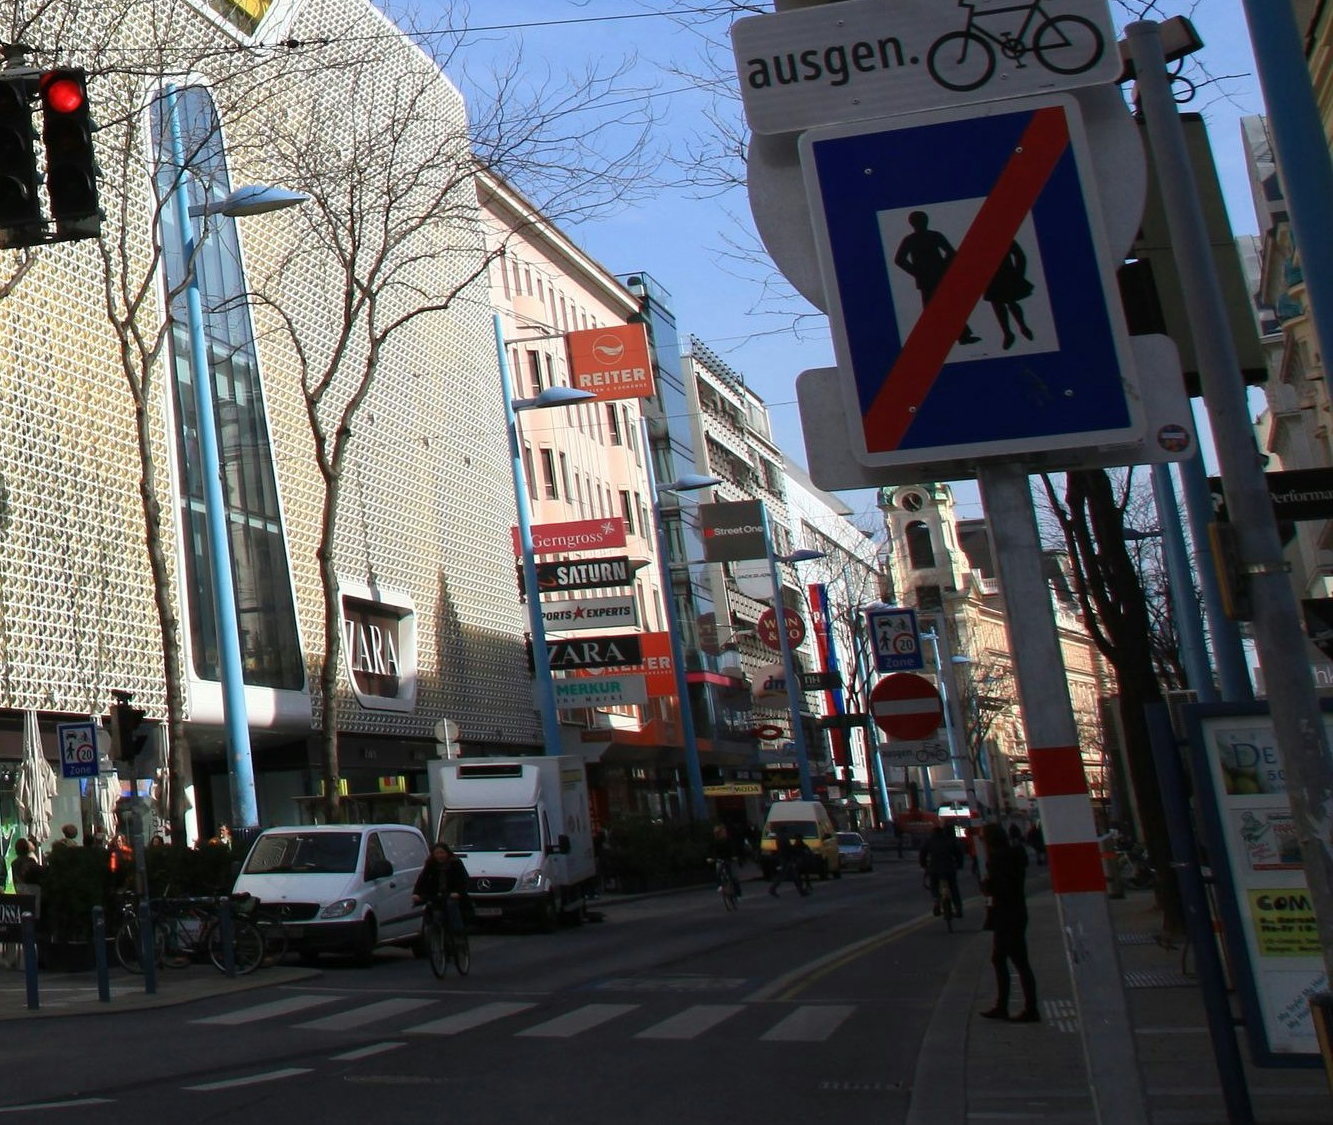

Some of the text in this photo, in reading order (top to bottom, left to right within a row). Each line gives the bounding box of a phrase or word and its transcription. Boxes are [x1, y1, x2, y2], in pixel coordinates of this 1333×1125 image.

[748, 36, 919, 89] ausgen.
[580, 368, 645, 387] REITER
[714, 525, 763, 536] Street One
[531, 532, 604, 550] Gerngross
[557, 562, 627, 586] SATURN
[542, 606, 630, 621] PORTS EXPERTS
[764, 618, 798, 629] WIN
[345, 619, 400, 676] ZARA
[900, 639, 913, 651] 20
[547, 642, 626, 665] ZARA
[885, 658, 914, 668] Zone
[556, 681, 622, 696] MERKUR
[81, 749, 92, 760] 20
[70, 766, 92, 774] Zone
